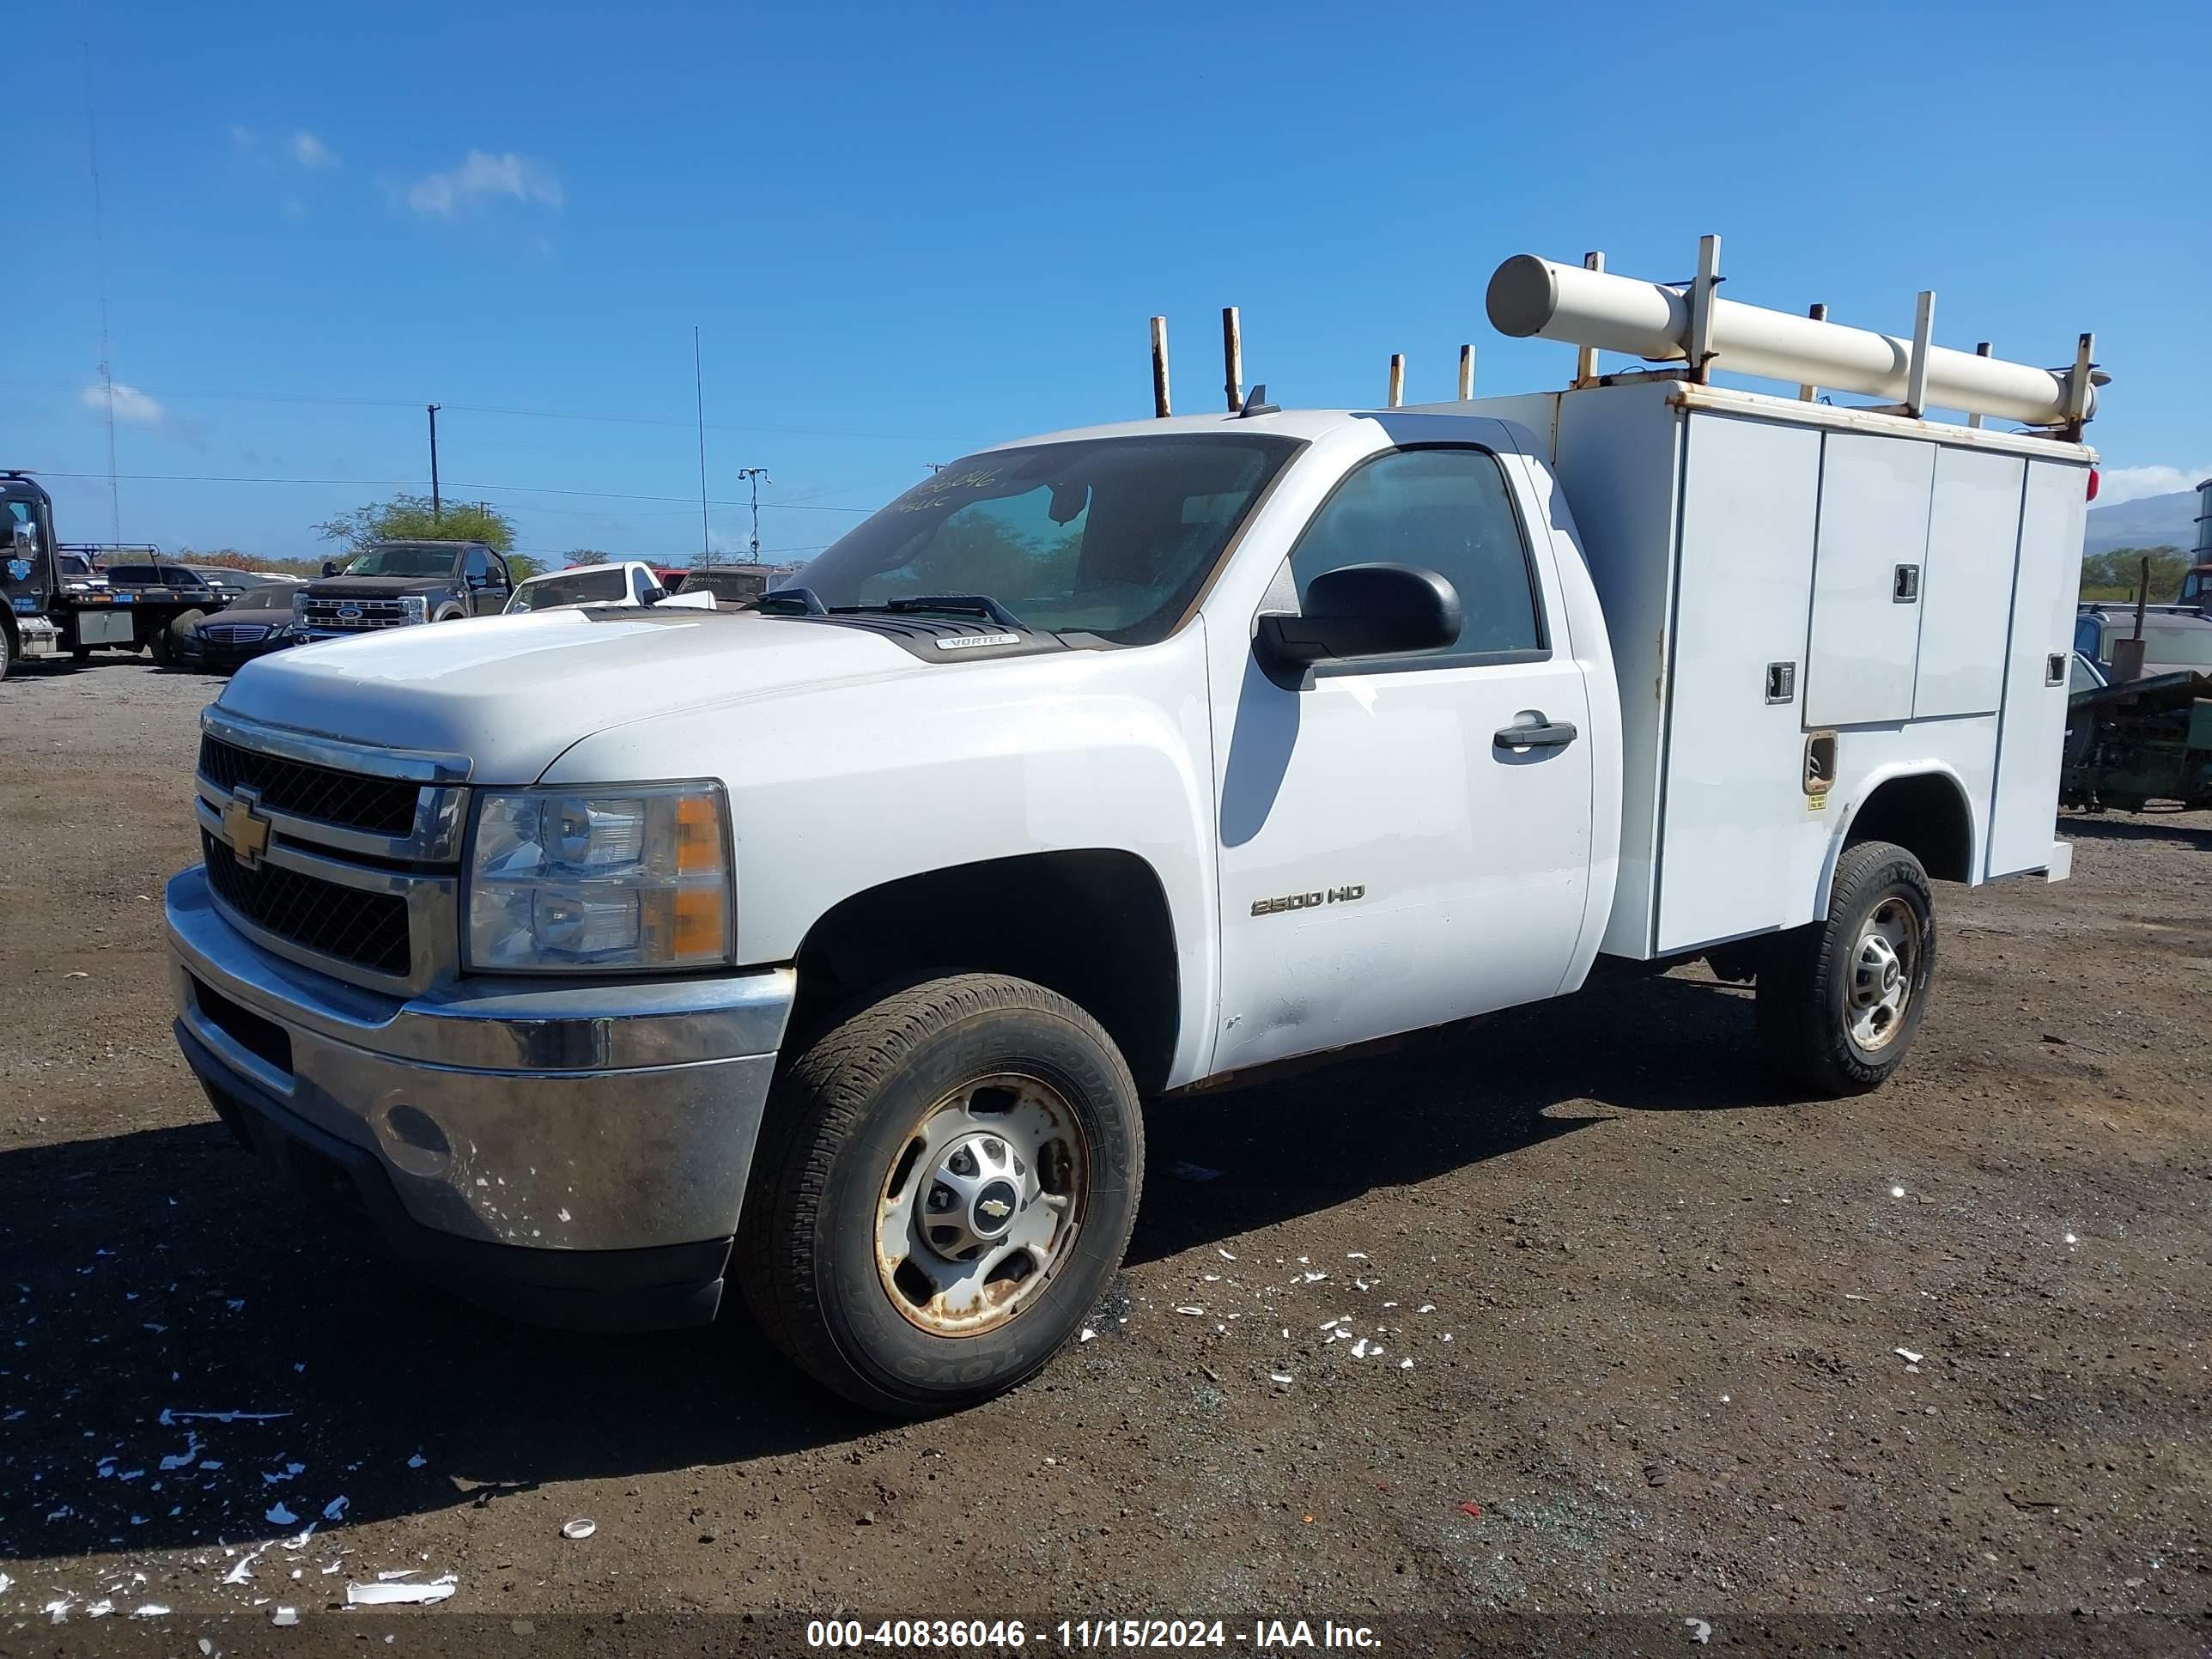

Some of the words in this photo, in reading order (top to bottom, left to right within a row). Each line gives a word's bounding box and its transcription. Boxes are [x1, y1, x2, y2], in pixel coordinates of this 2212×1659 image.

[951, 635, 1008, 647] VORTEC
[1251, 890, 1324, 916] 2500
[1328, 884, 1366, 904] HD
[896, 1347, 1024, 1383] TOYO
